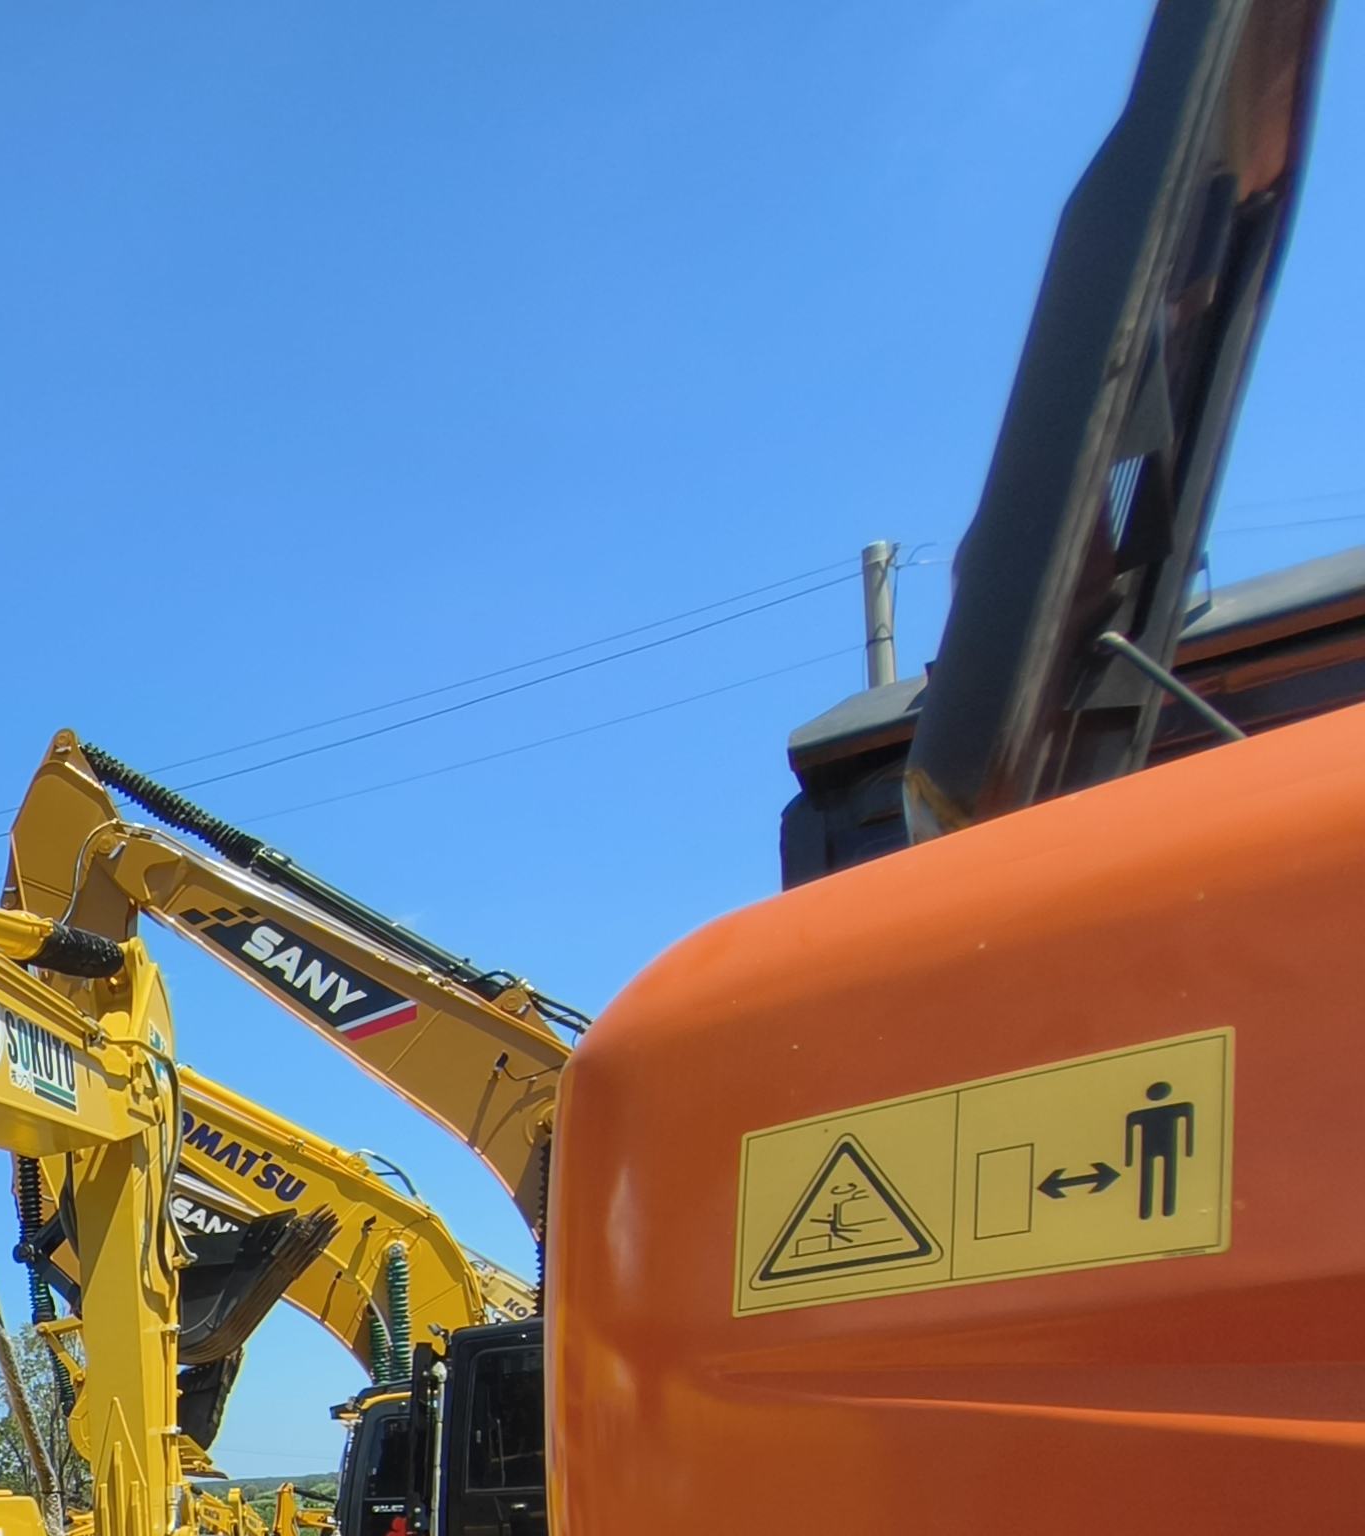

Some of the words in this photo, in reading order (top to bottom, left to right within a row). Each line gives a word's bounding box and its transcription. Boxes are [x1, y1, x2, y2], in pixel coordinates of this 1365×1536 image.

[241, 926, 367, 1013] SANY
[5, 1010, 75, 1092] SOKUTO
[172, 1197, 239, 1234] SAN
